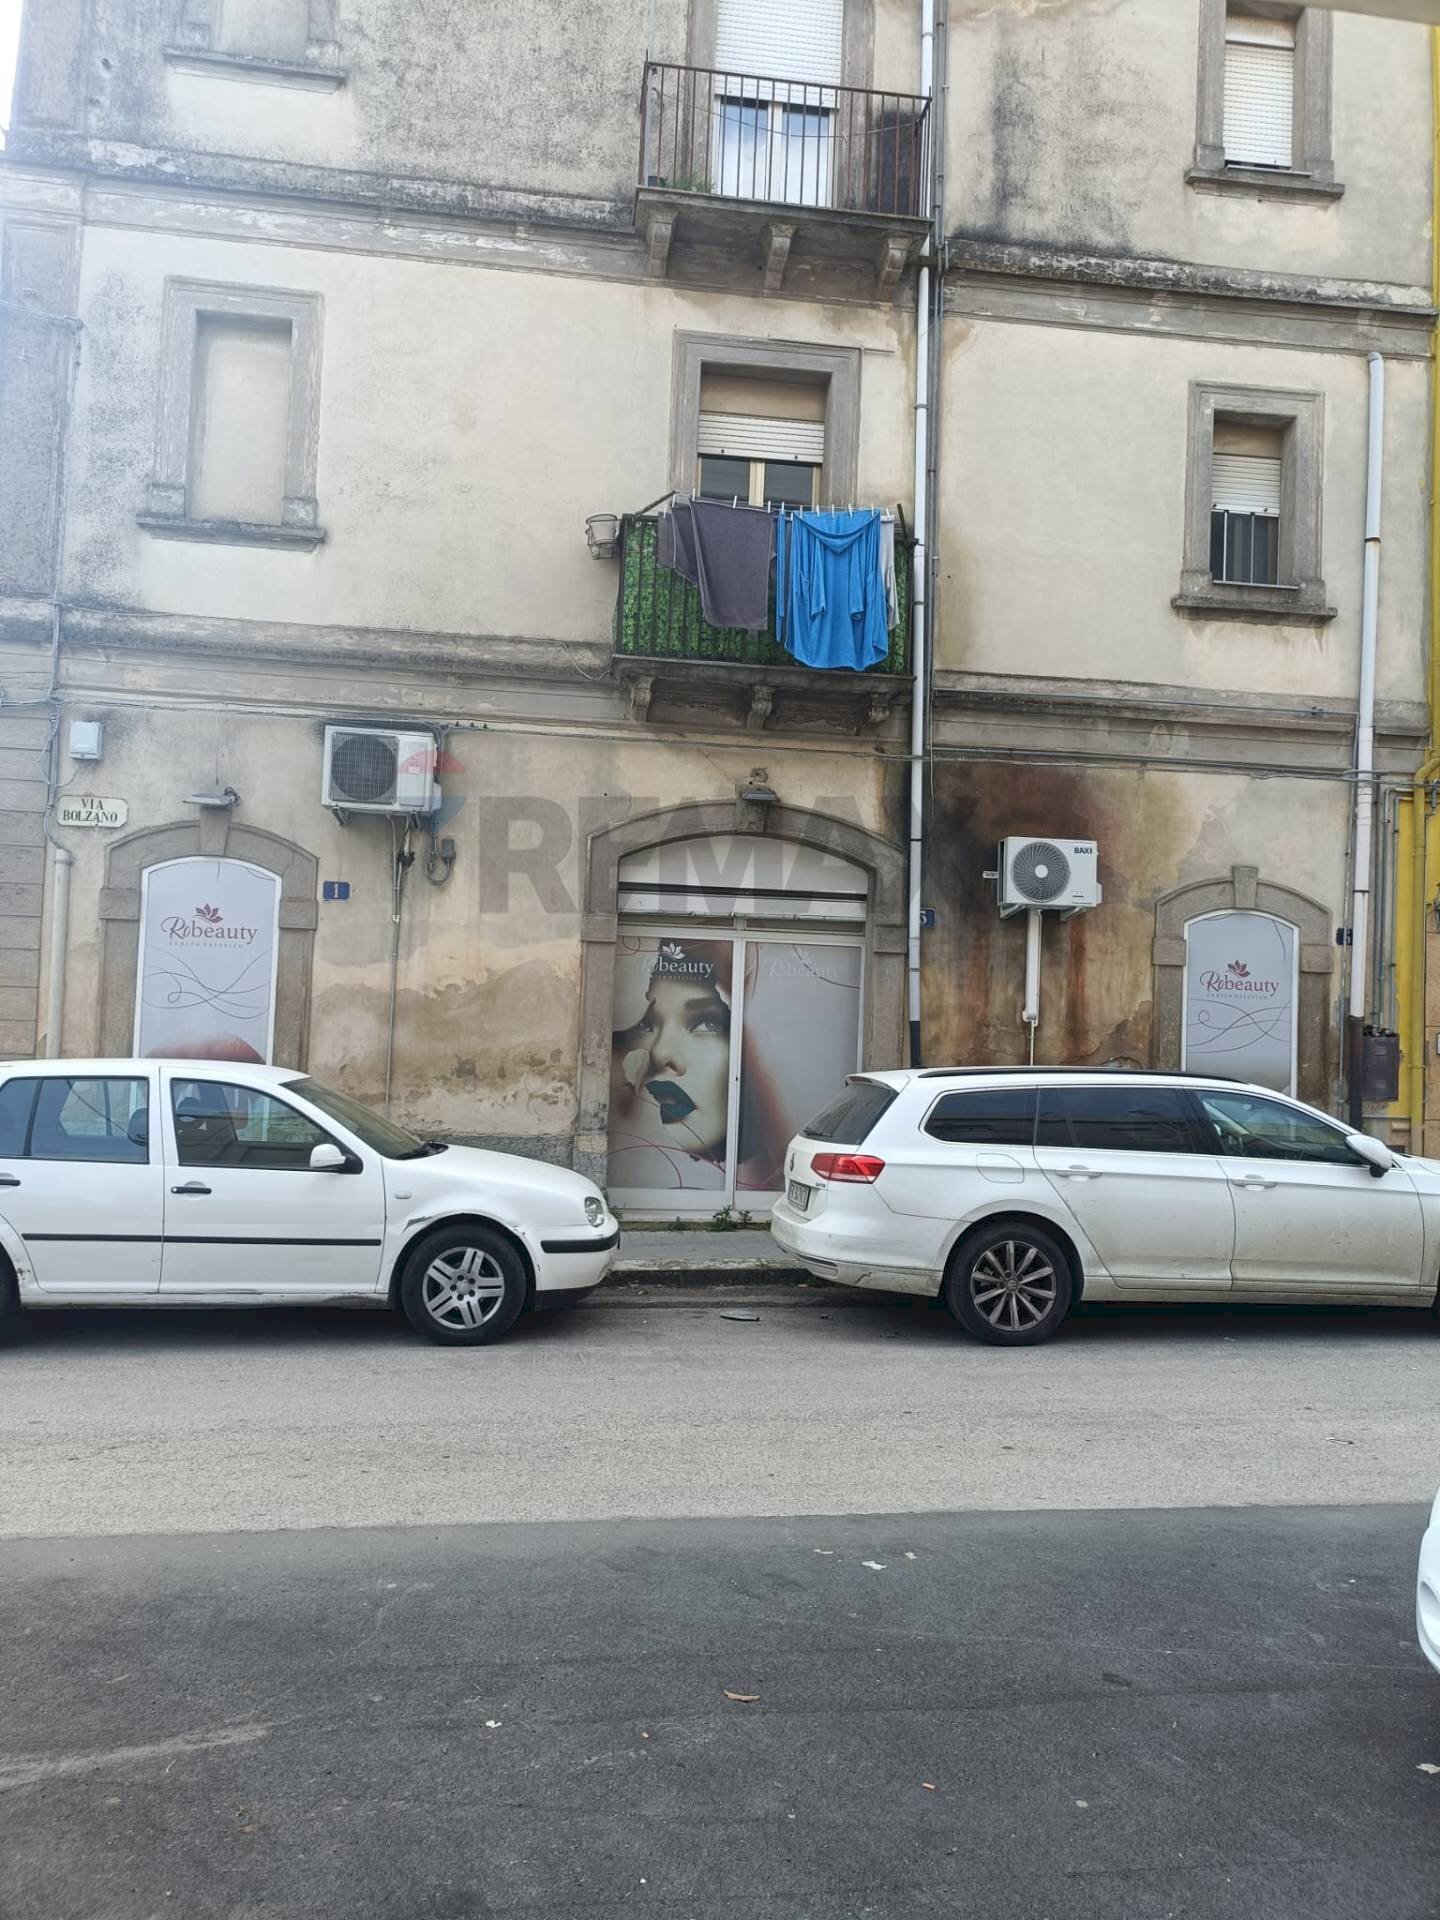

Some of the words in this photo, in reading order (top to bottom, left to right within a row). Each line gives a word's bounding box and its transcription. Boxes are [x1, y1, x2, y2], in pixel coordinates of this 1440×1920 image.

[81, 798, 104, 811] VIA
[63, 809, 118, 823] BOLZANO
[333, 883, 339, 898] 1
[160, 916, 258, 945] Robeauty
[1199, 970, 1280, 997] Robeauty
